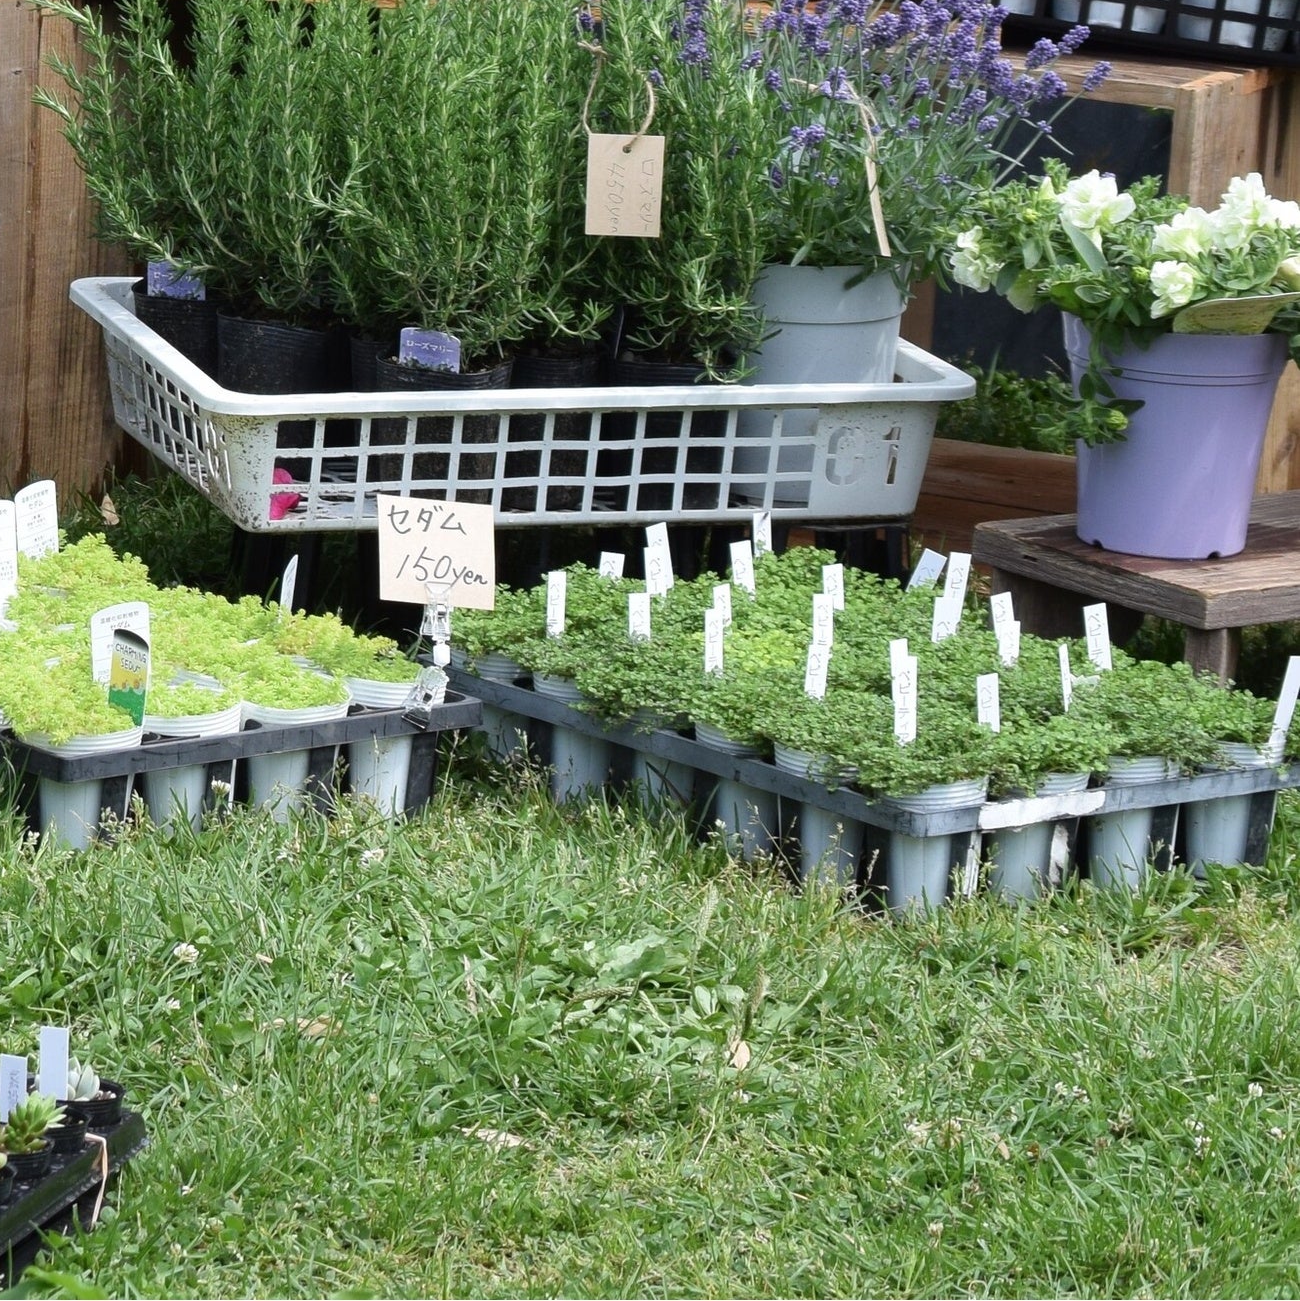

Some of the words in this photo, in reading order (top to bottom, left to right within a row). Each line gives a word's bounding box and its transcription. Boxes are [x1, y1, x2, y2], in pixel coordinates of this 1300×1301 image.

[406, 339, 454, 353] ローズマリー
[387, 505, 468, 535] セダム
[396, 546, 488, 588] 150yen
[115, 643, 147, 664] CHARMING
